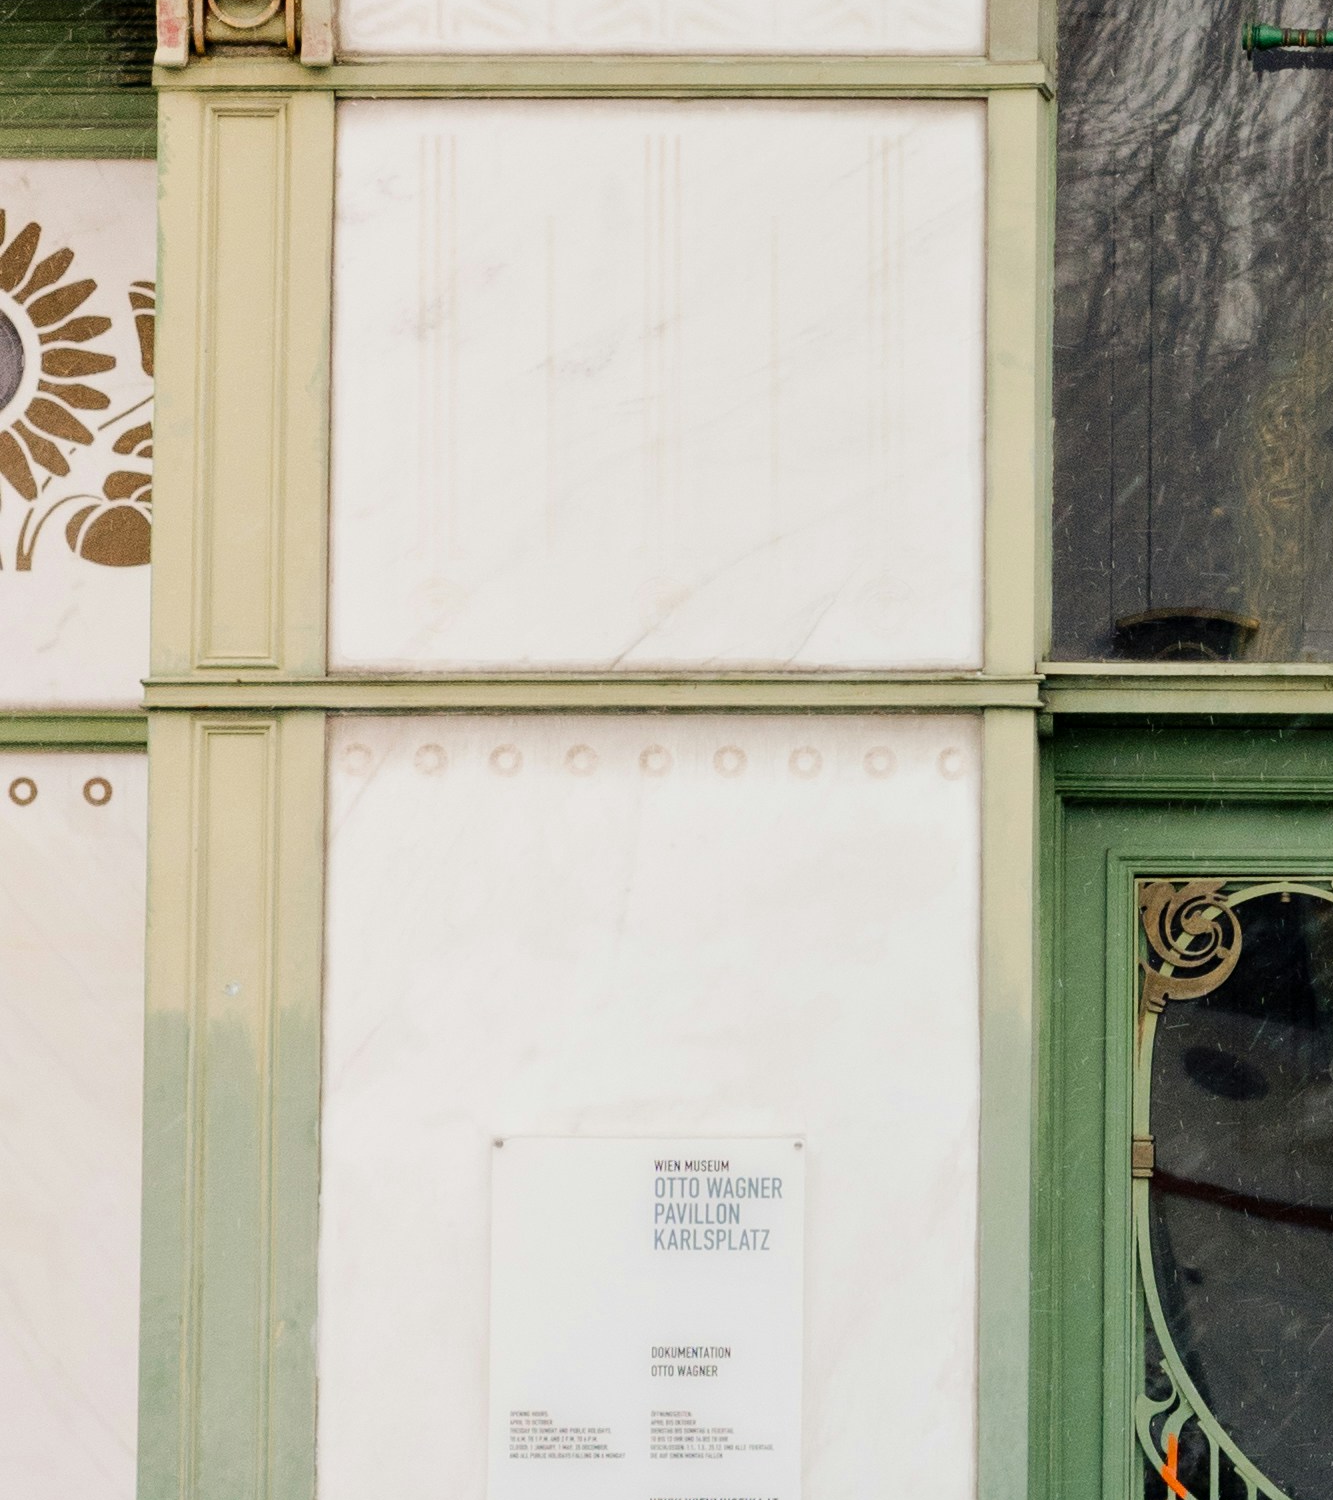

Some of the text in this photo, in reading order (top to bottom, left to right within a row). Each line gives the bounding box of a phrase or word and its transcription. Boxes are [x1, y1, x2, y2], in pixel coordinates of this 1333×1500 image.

[654, 1159, 730, 1172] WIEN MUSEUM
[654, 1177, 783, 1199] OTTO WAGNER
[654, 1203, 740, 1225] PAVILLON
[654, 1229, 770, 1251] KARLSPLATZ
[650, 1346, 732, 1359] DOKUMENTATION
[650, 1365, 719, 1378] OTTO WAGNER
